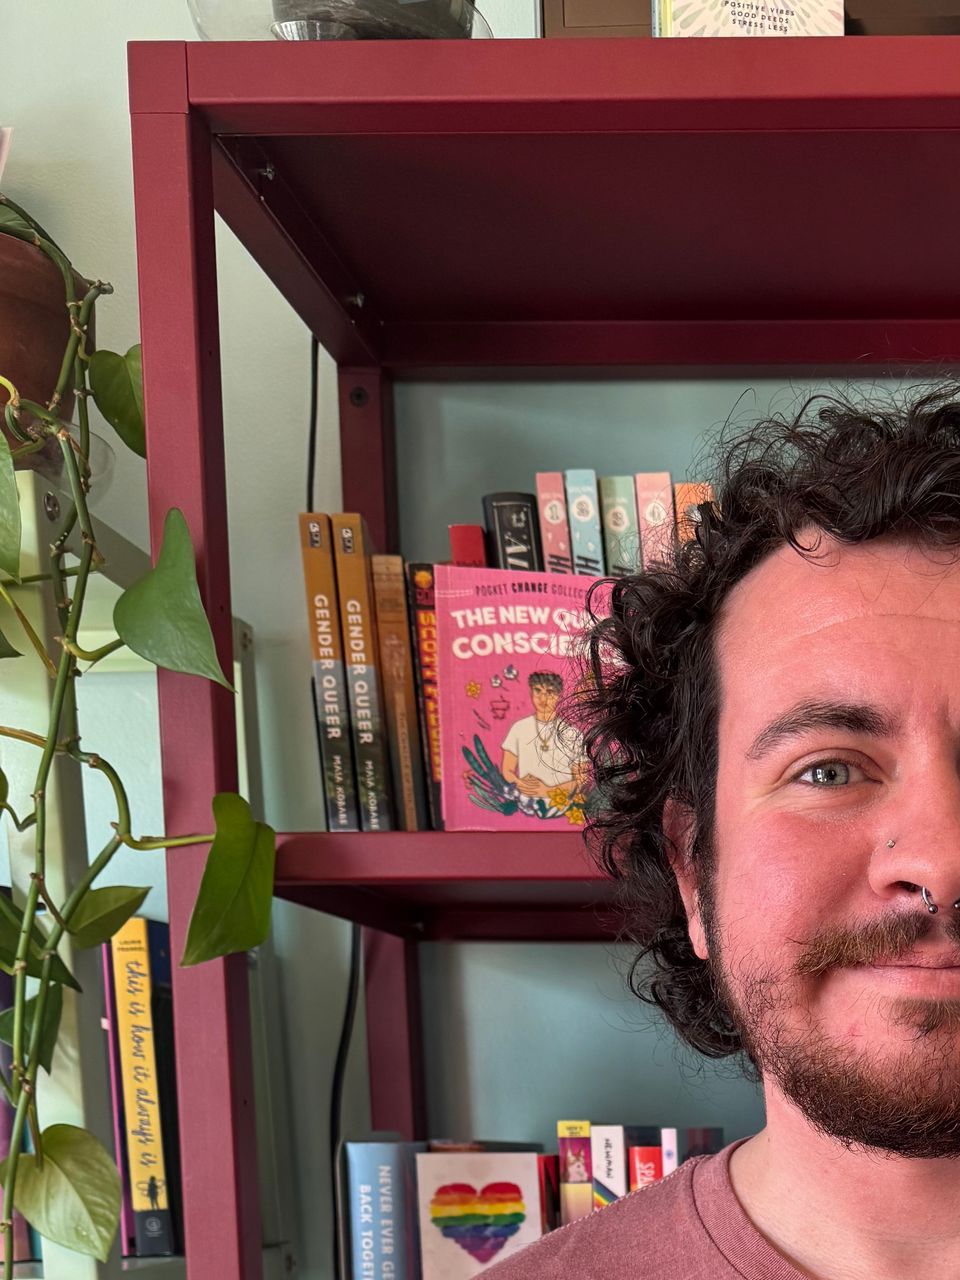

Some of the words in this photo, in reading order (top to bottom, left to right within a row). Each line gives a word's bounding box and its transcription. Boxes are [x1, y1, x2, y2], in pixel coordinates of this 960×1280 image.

[724, 1, 766, 12] POSITIVE
[770, 8, 796, 17] VIBES
[730, 11, 757, 19] GOOD
[761, 15, 790, 24] DEEDS
[732, 18, 764, 29] STRESS
[768, 24, 789, 33] LESS
[475, 583, 507, 596] POCKET
[511, 582, 548, 594] CHANGE
[314, 594, 334, 670] GENDER
[451, 608, 497, 629] THE
[501, 605, 549, 625] NEW
[323, 675, 342, 740] QUEER
[332, 755, 345, 783] MAIA
[335, 786, 348, 826] KOBABE
[126, 960, 148, 996] this
[131, 1001, 146, 1016] is
[130, 1024, 152, 1060] how
[133, 1065, 151, 1084] it
[131, 1088, 156, 1145] always
[140, 1151, 157, 1168] is
[603, 1138, 615, 1179] NEWMAN
[359, 1184, 373, 1223] BACK
[378, 1165, 393, 1214] NEVER
[380, 1219, 395, 1255] EVER
